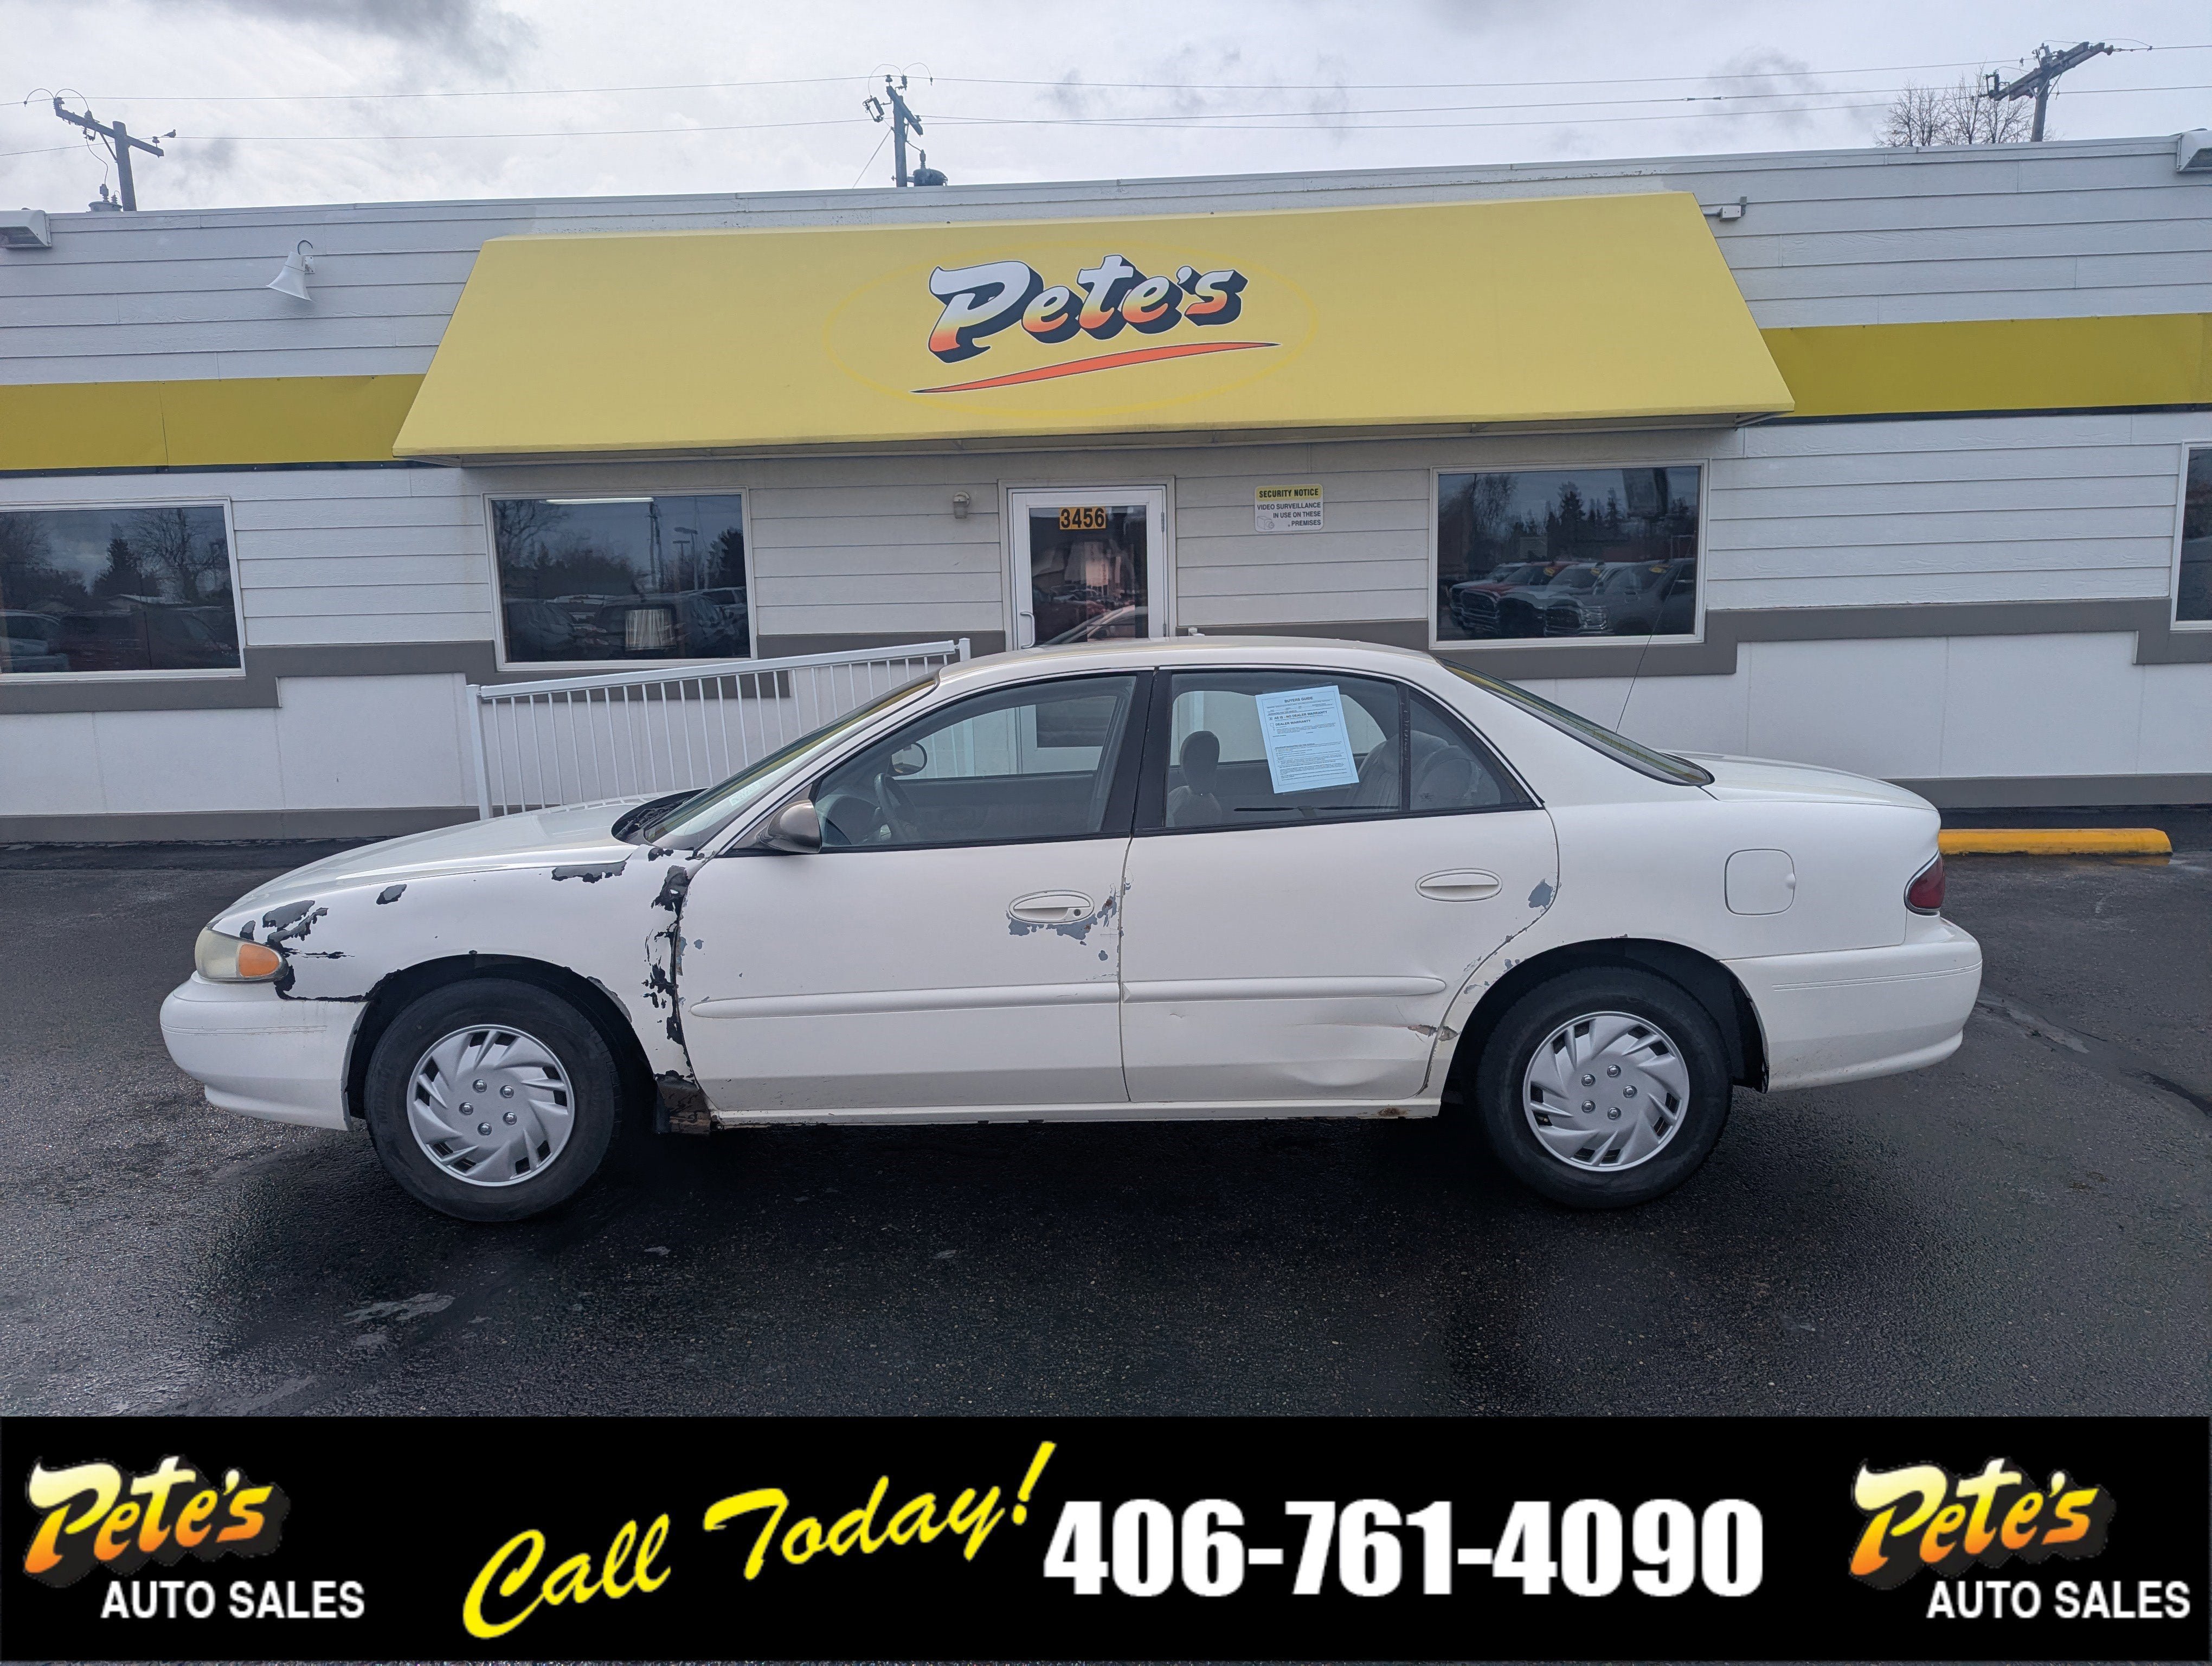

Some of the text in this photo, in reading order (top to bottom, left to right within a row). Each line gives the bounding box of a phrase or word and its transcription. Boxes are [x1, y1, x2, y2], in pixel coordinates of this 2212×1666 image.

[928, 254, 1248, 363] Pete's
[1259, 490, 1291, 498] SECURITY
[1060, 507, 1104, 529] 3456
